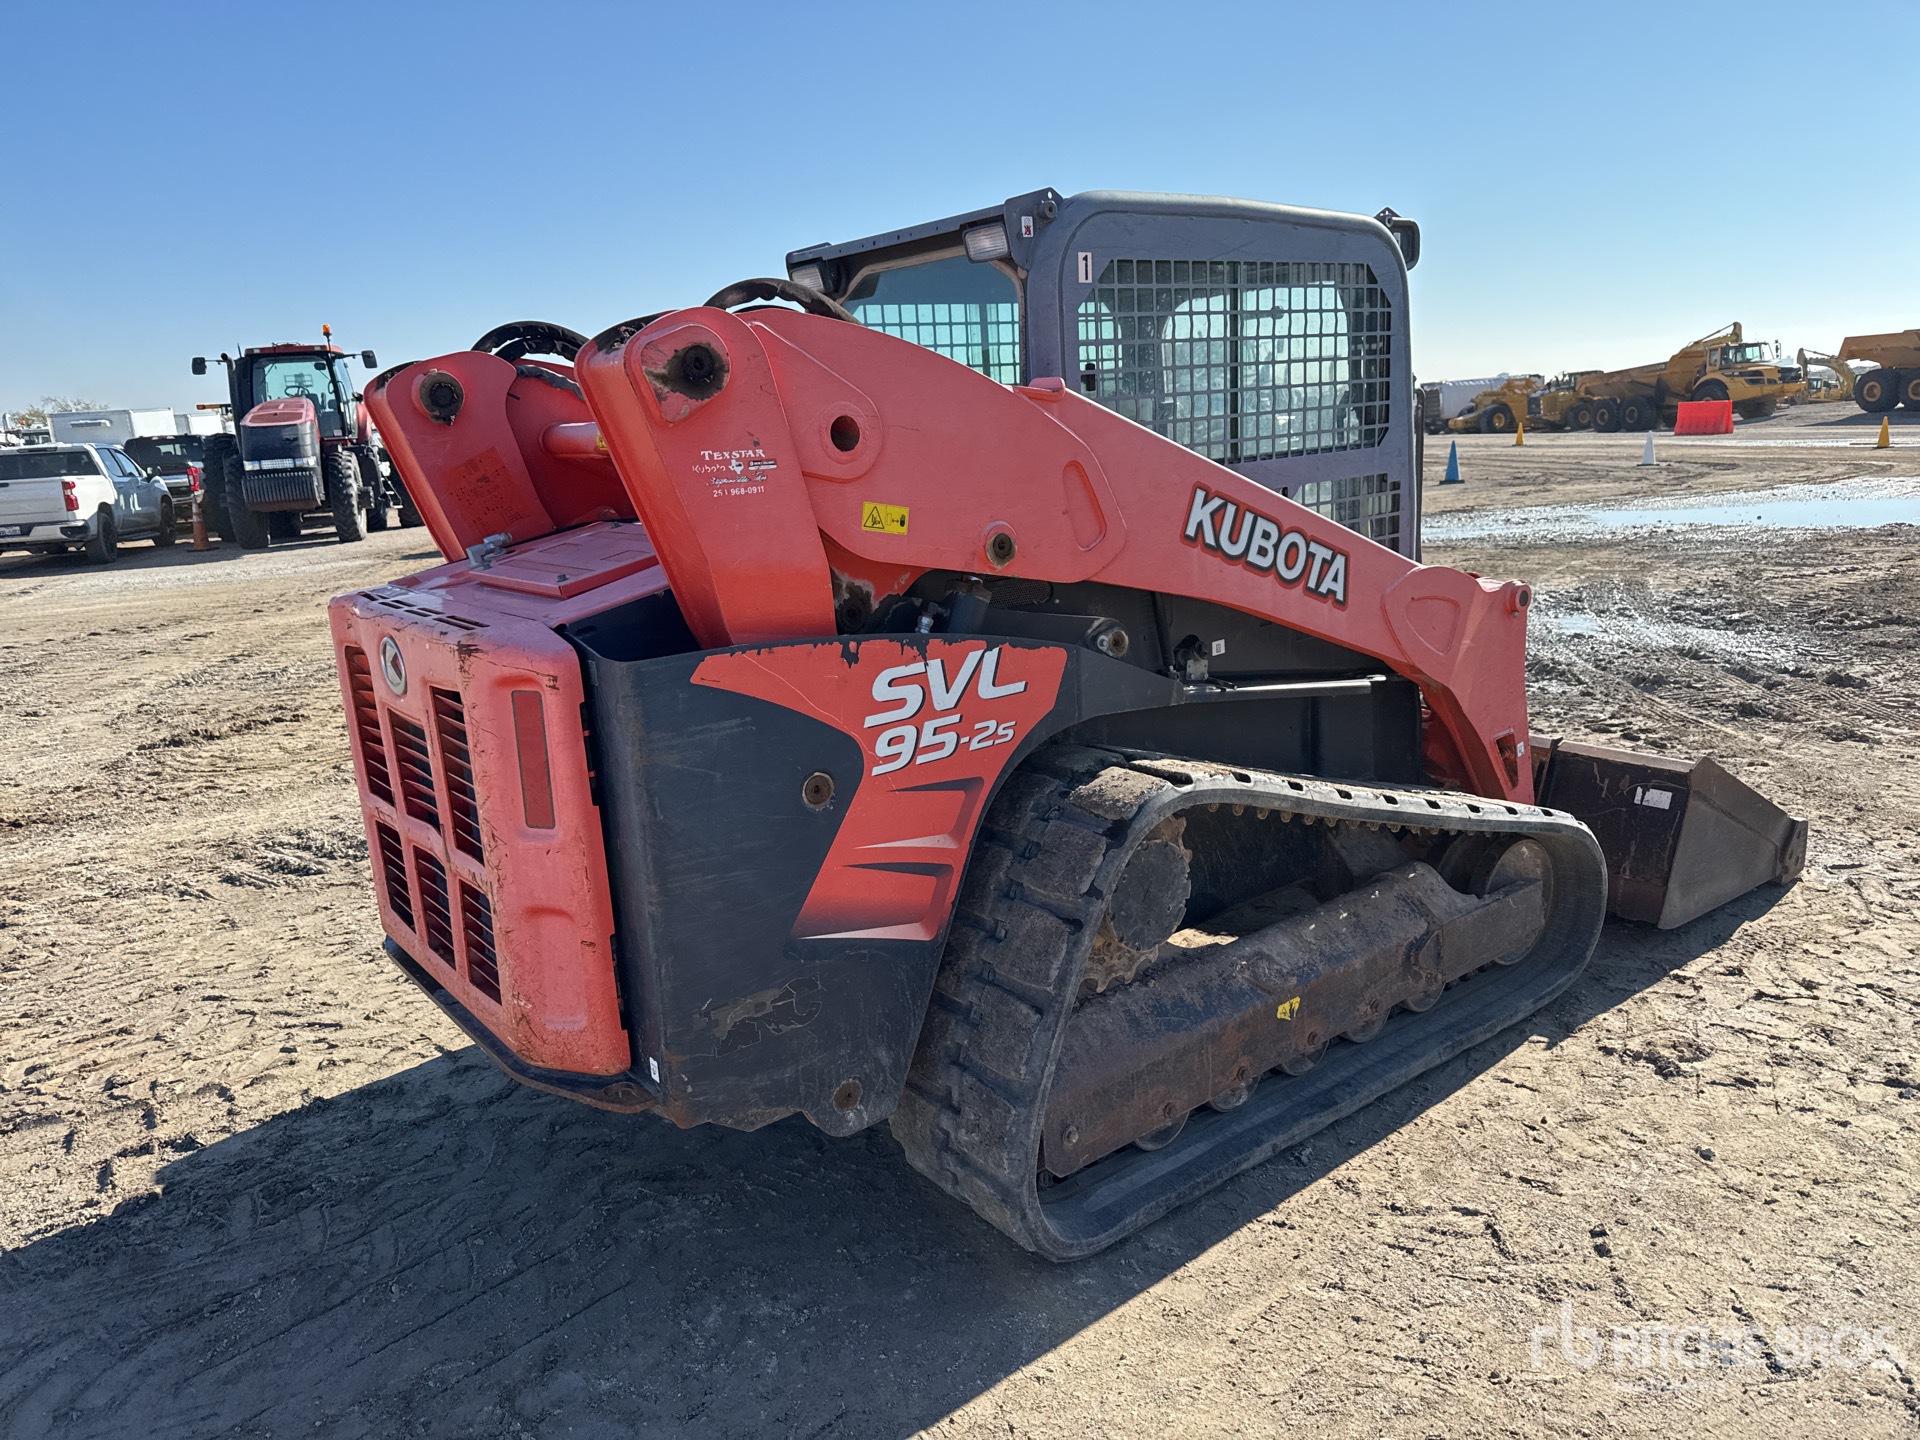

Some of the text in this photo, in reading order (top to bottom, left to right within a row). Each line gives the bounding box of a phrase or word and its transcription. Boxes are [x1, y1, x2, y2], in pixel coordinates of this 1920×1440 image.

[1082, 254, 1089, 281] 1
[730, 486, 765, 497] 968-0911
[1183, 487, 1346, 602] KUBOTA
[863, 647, 1028, 728] SVL
